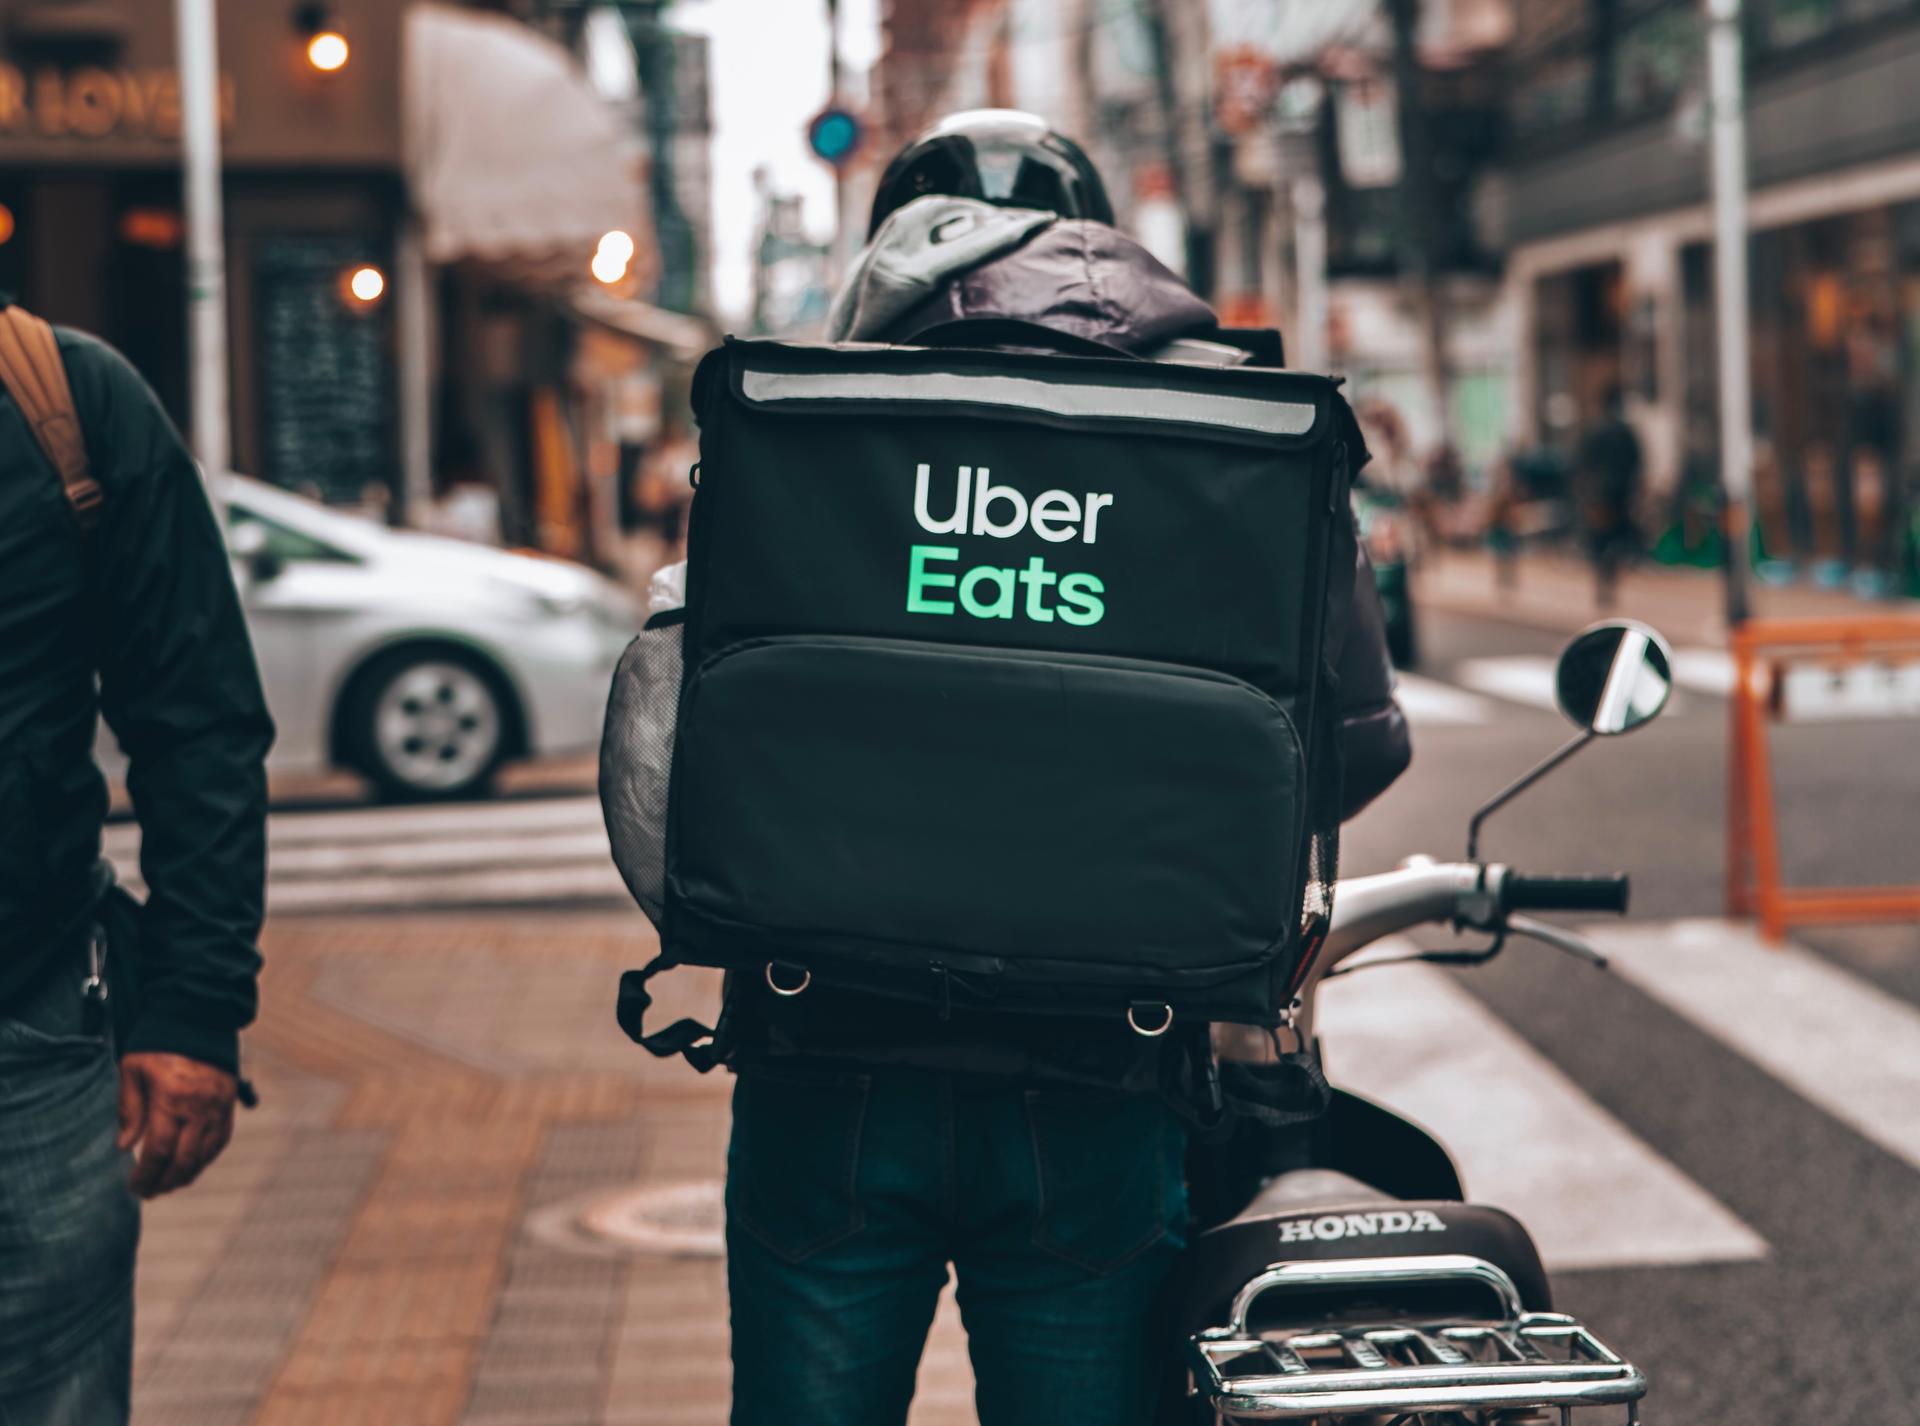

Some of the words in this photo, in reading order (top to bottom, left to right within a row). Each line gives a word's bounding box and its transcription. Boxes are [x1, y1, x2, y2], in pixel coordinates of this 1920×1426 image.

[913, 463, 1114, 544] Uber
[906, 544, 1105, 627] Eats
[1278, 1209, 1448, 1243] HONDA
